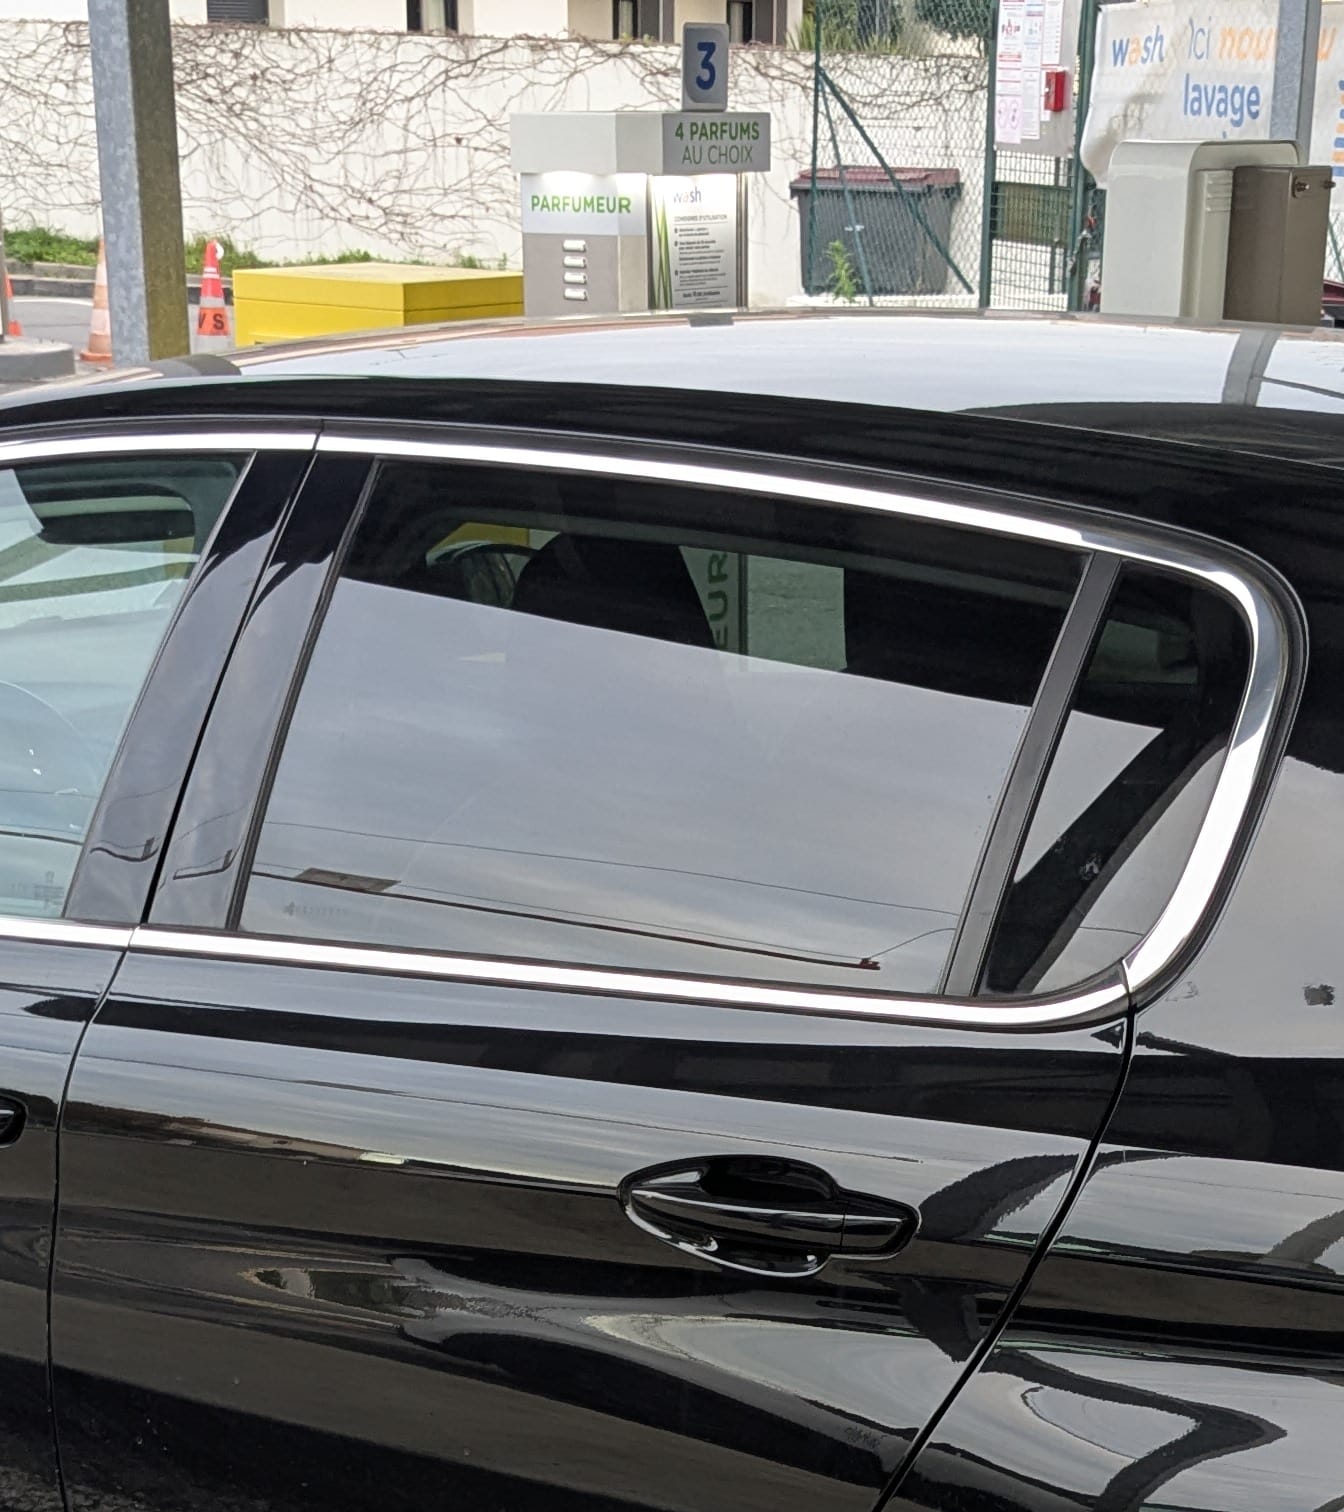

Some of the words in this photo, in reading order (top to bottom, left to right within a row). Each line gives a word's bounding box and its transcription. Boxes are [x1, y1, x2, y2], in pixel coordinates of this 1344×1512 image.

[1112, 24, 1165, 67] wash
[695, 41, 717, 91] 3
[1183, 73, 1261, 128] lavage
[674, 123, 684, 141] 4
[690, 122, 760, 141] PARFUMS
[682, 145, 703, 165] AU
[707, 144, 753, 165] CHOIX
[531, 195, 632, 214] PARFUMEUR
